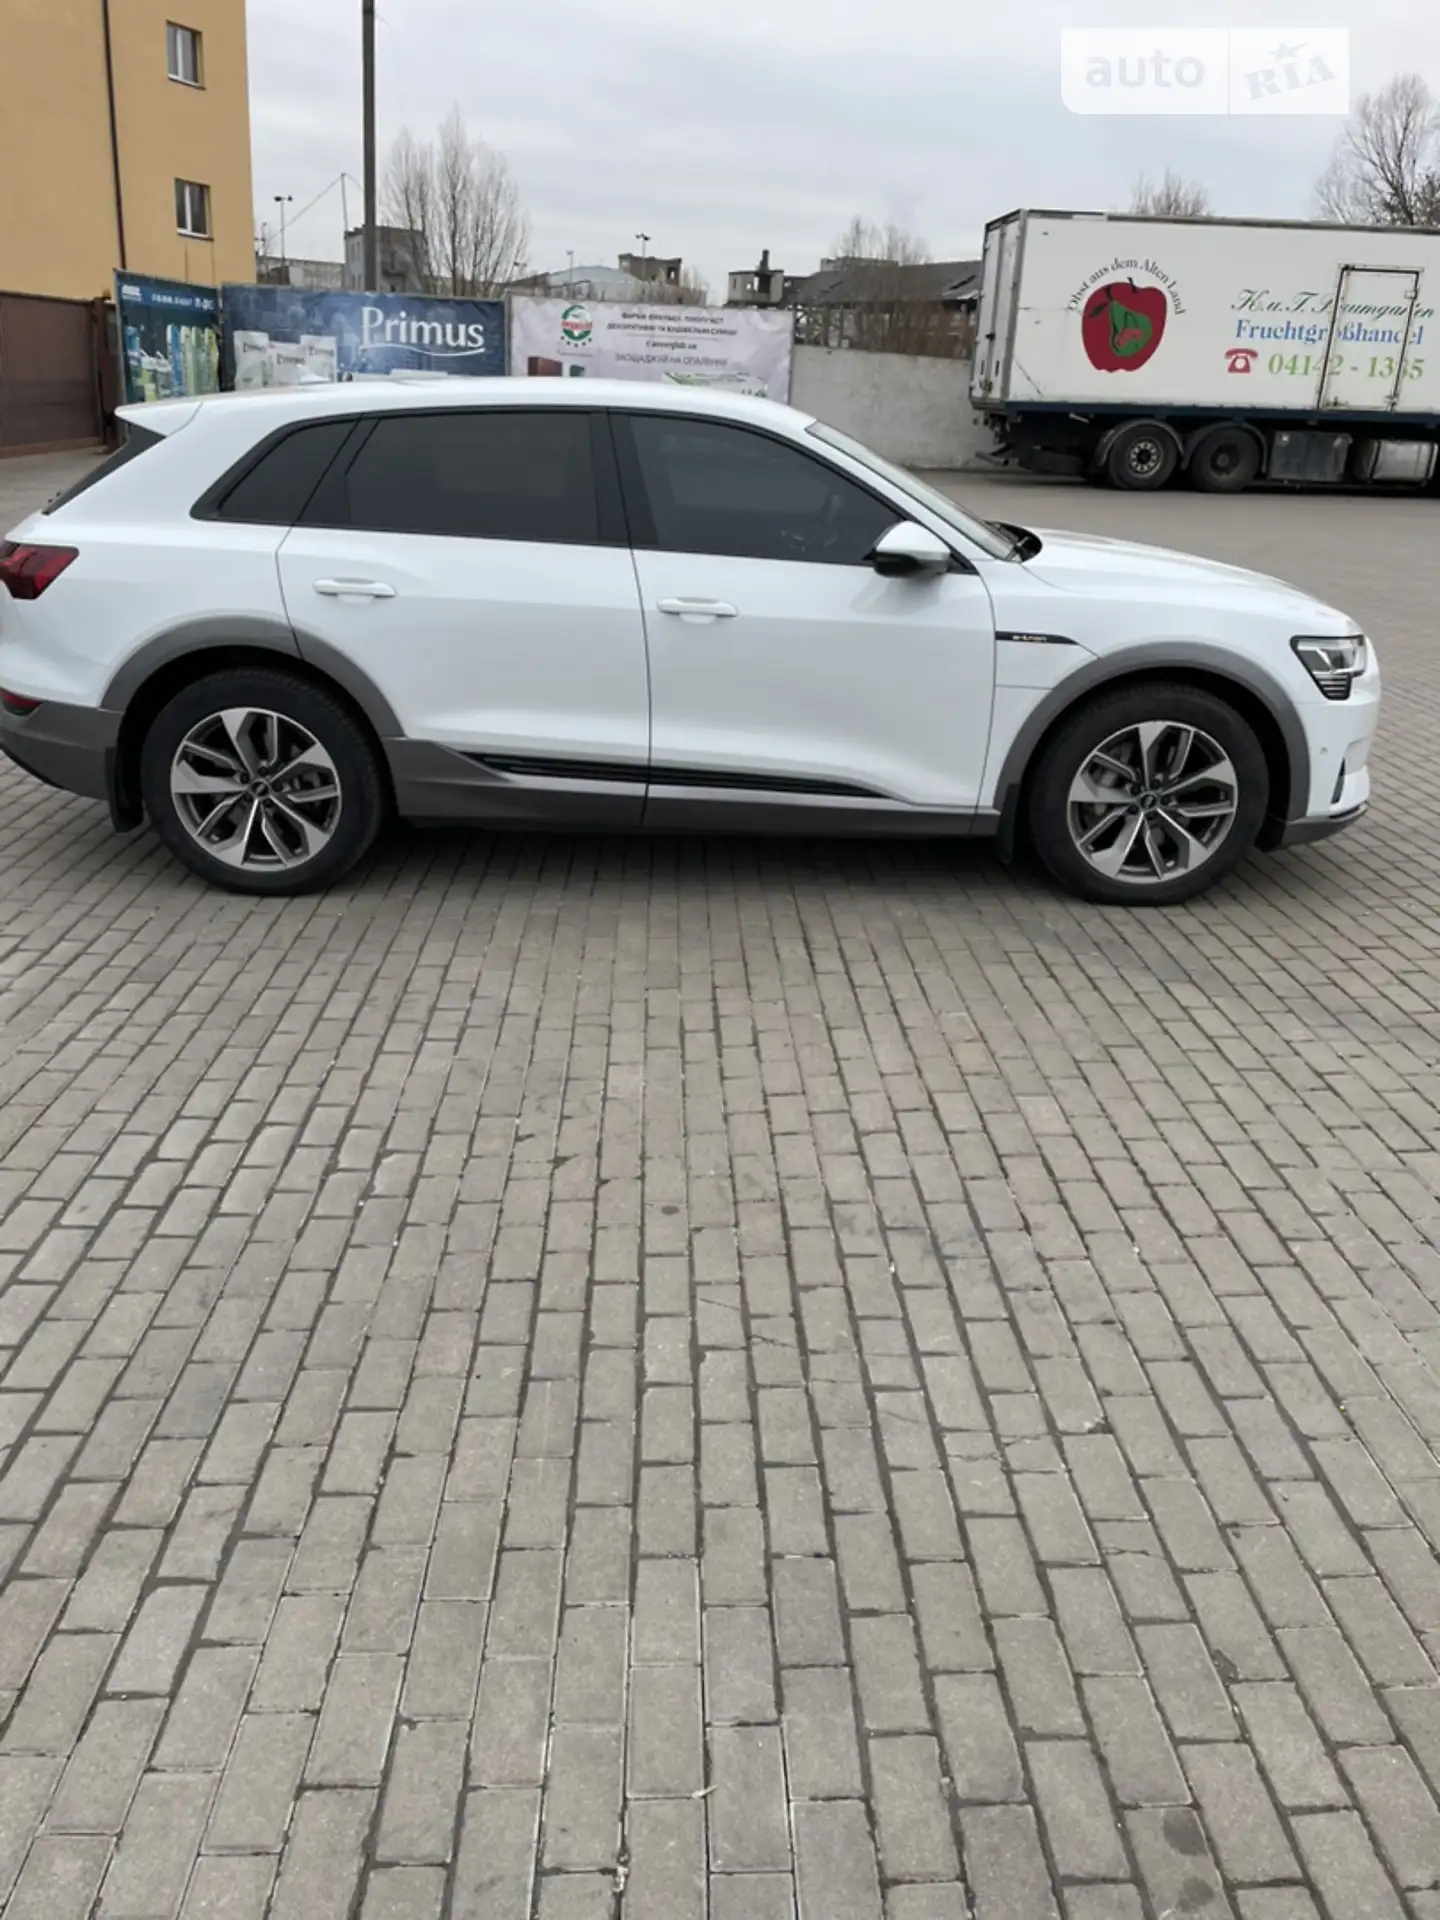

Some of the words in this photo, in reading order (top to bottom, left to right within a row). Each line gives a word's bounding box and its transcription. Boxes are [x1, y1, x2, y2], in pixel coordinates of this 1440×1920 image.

[1067, 281, 1090, 312] Obst
[1089, 267, 1109, 284] aus
[1111, 257, 1138, 271] dem
[1139, 258, 1171, 284] Alten
[1167, 280, 1187, 316] Land
[361, 306, 485, 349] Primus
